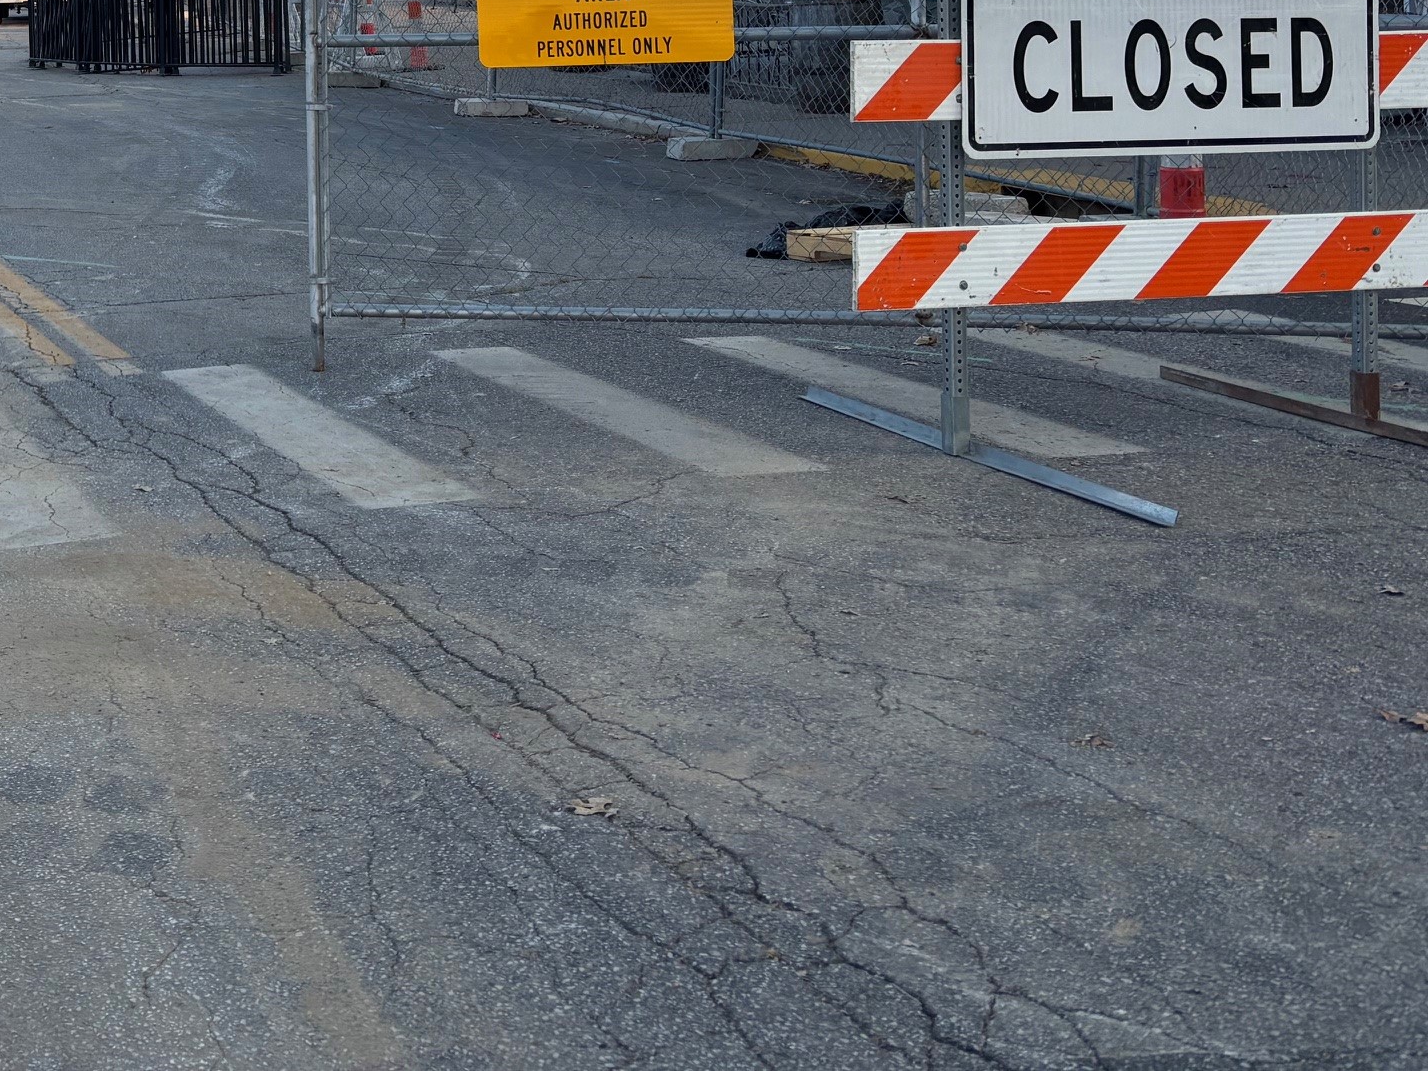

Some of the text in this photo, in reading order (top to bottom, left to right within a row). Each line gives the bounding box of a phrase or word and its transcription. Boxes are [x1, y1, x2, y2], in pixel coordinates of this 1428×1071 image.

[553, 10, 648, 30] AUTHORIZED
[537, 37, 672, 58] PERSONNEL ONLY
[1013, 17, 1334, 113] CLOSED
